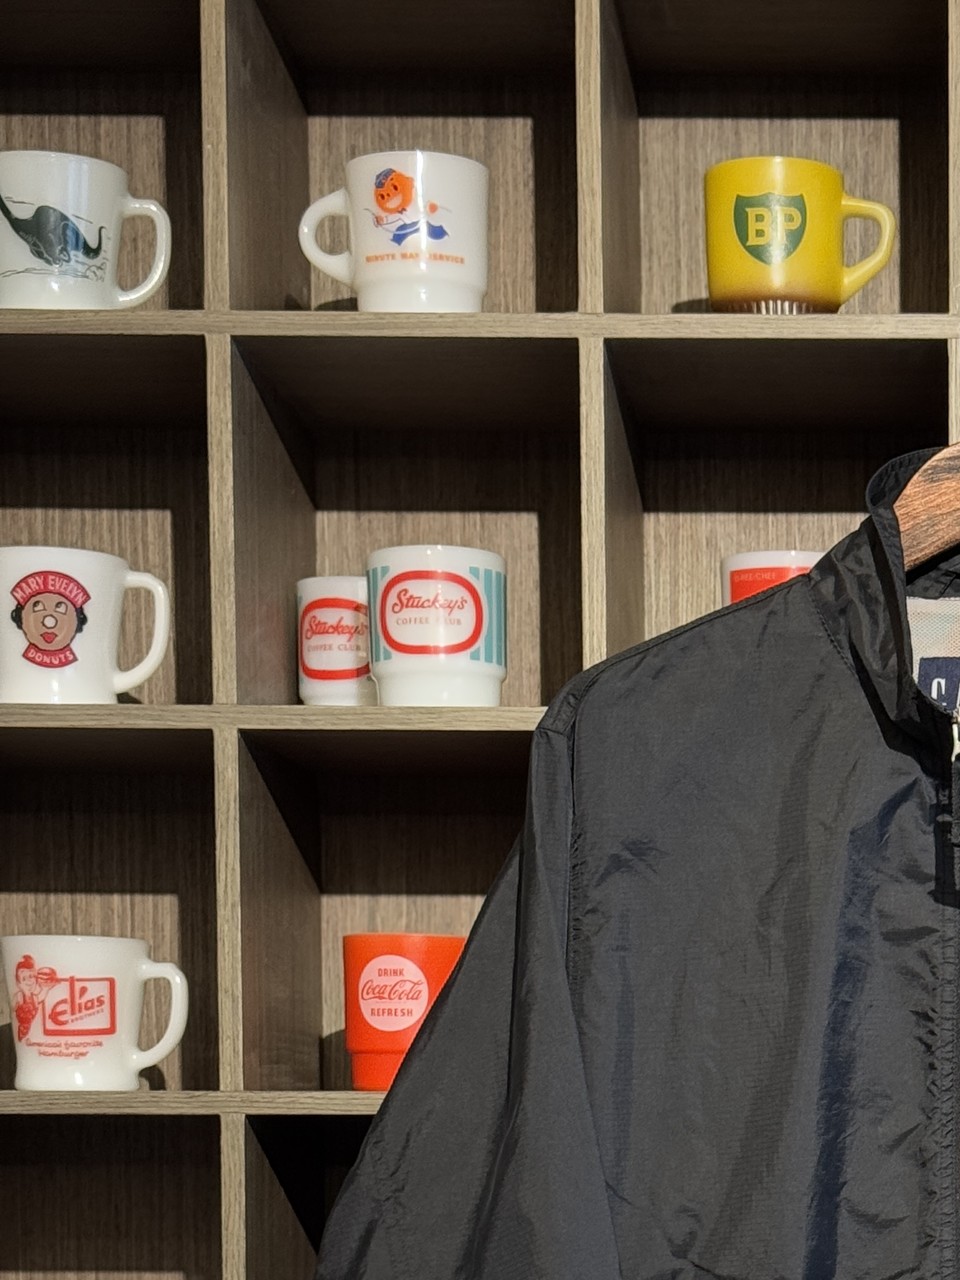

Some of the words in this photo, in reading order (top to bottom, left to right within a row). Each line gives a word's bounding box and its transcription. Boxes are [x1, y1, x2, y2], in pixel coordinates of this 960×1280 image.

[745, 206, 802, 246] BP
[13, 575, 45, 602] MARY
[48, 575, 87, 607] EVELYN
[392, 588, 468, 616] Stuckey's
[305, 615, 368, 642] Stuckey's
[435, 618, 463, 626] LUB
[28, 649, 74, 664] DONUTS
[377, 968, 405, 977] DRINK
[361, 979, 424, 1001] Coca-Cola
[370, 1007, 414, 1017] REFRESH
